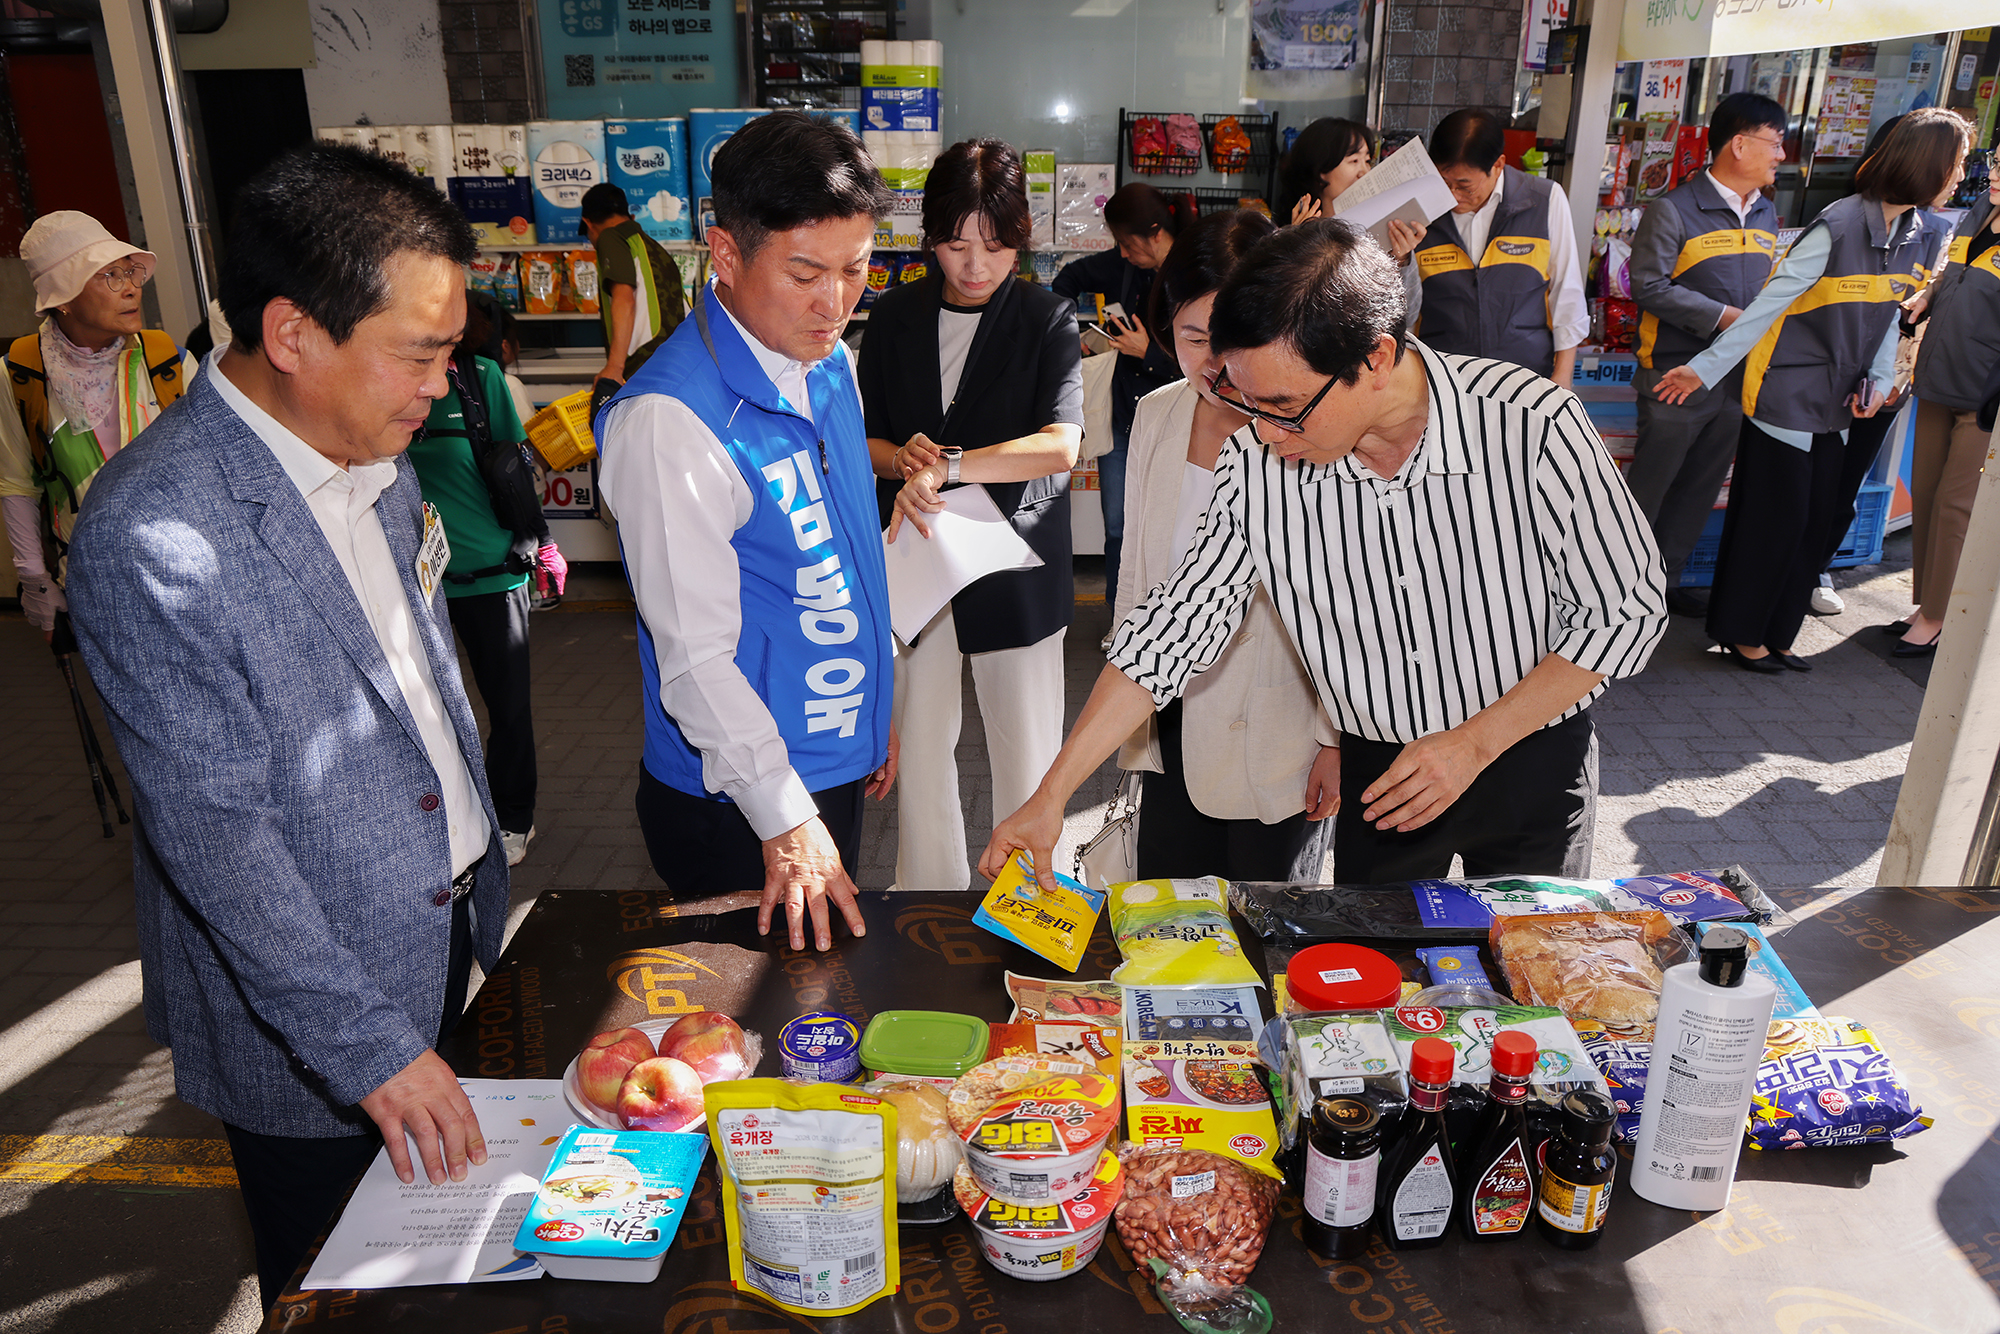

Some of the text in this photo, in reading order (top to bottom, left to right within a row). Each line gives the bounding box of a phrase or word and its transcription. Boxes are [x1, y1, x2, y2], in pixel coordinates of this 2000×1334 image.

[582, 16, 603, 30] GS
[628, 19, 712, 35] 하나의 앱으로
[1300, 24, 1353, 43] 1900
[1663, 75, 1682, 99] 1+1
[621, 153, 665, 170] 잘풀리는집
[541, 168, 592, 182] 크리넥스
[875, 233, 918, 247] 12,800
[900, 265, 928, 284] 테크
[1176, 999, 1215, 1008] 마스크
[1218, 1000, 1244, 1015] K
[811, 1026, 836, 1035] 참치
[796, 1034, 844, 1046] 마일드
[1686, 1033, 1701, 1047] 17
[1163, 1041, 1226, 1057] 밤양갱
[1823, 1094, 1842, 1103] 오뚜기
[1014, 1100, 1094, 1127] 육개장
[1139, 1115, 1205, 1134] 짜장
[729, 1130, 773, 1146] 육개장
[981, 1122, 1053, 1145] BIG
[988, 1200, 1060, 1221] BIG
[1039, 1252, 1060, 1264] BIG
